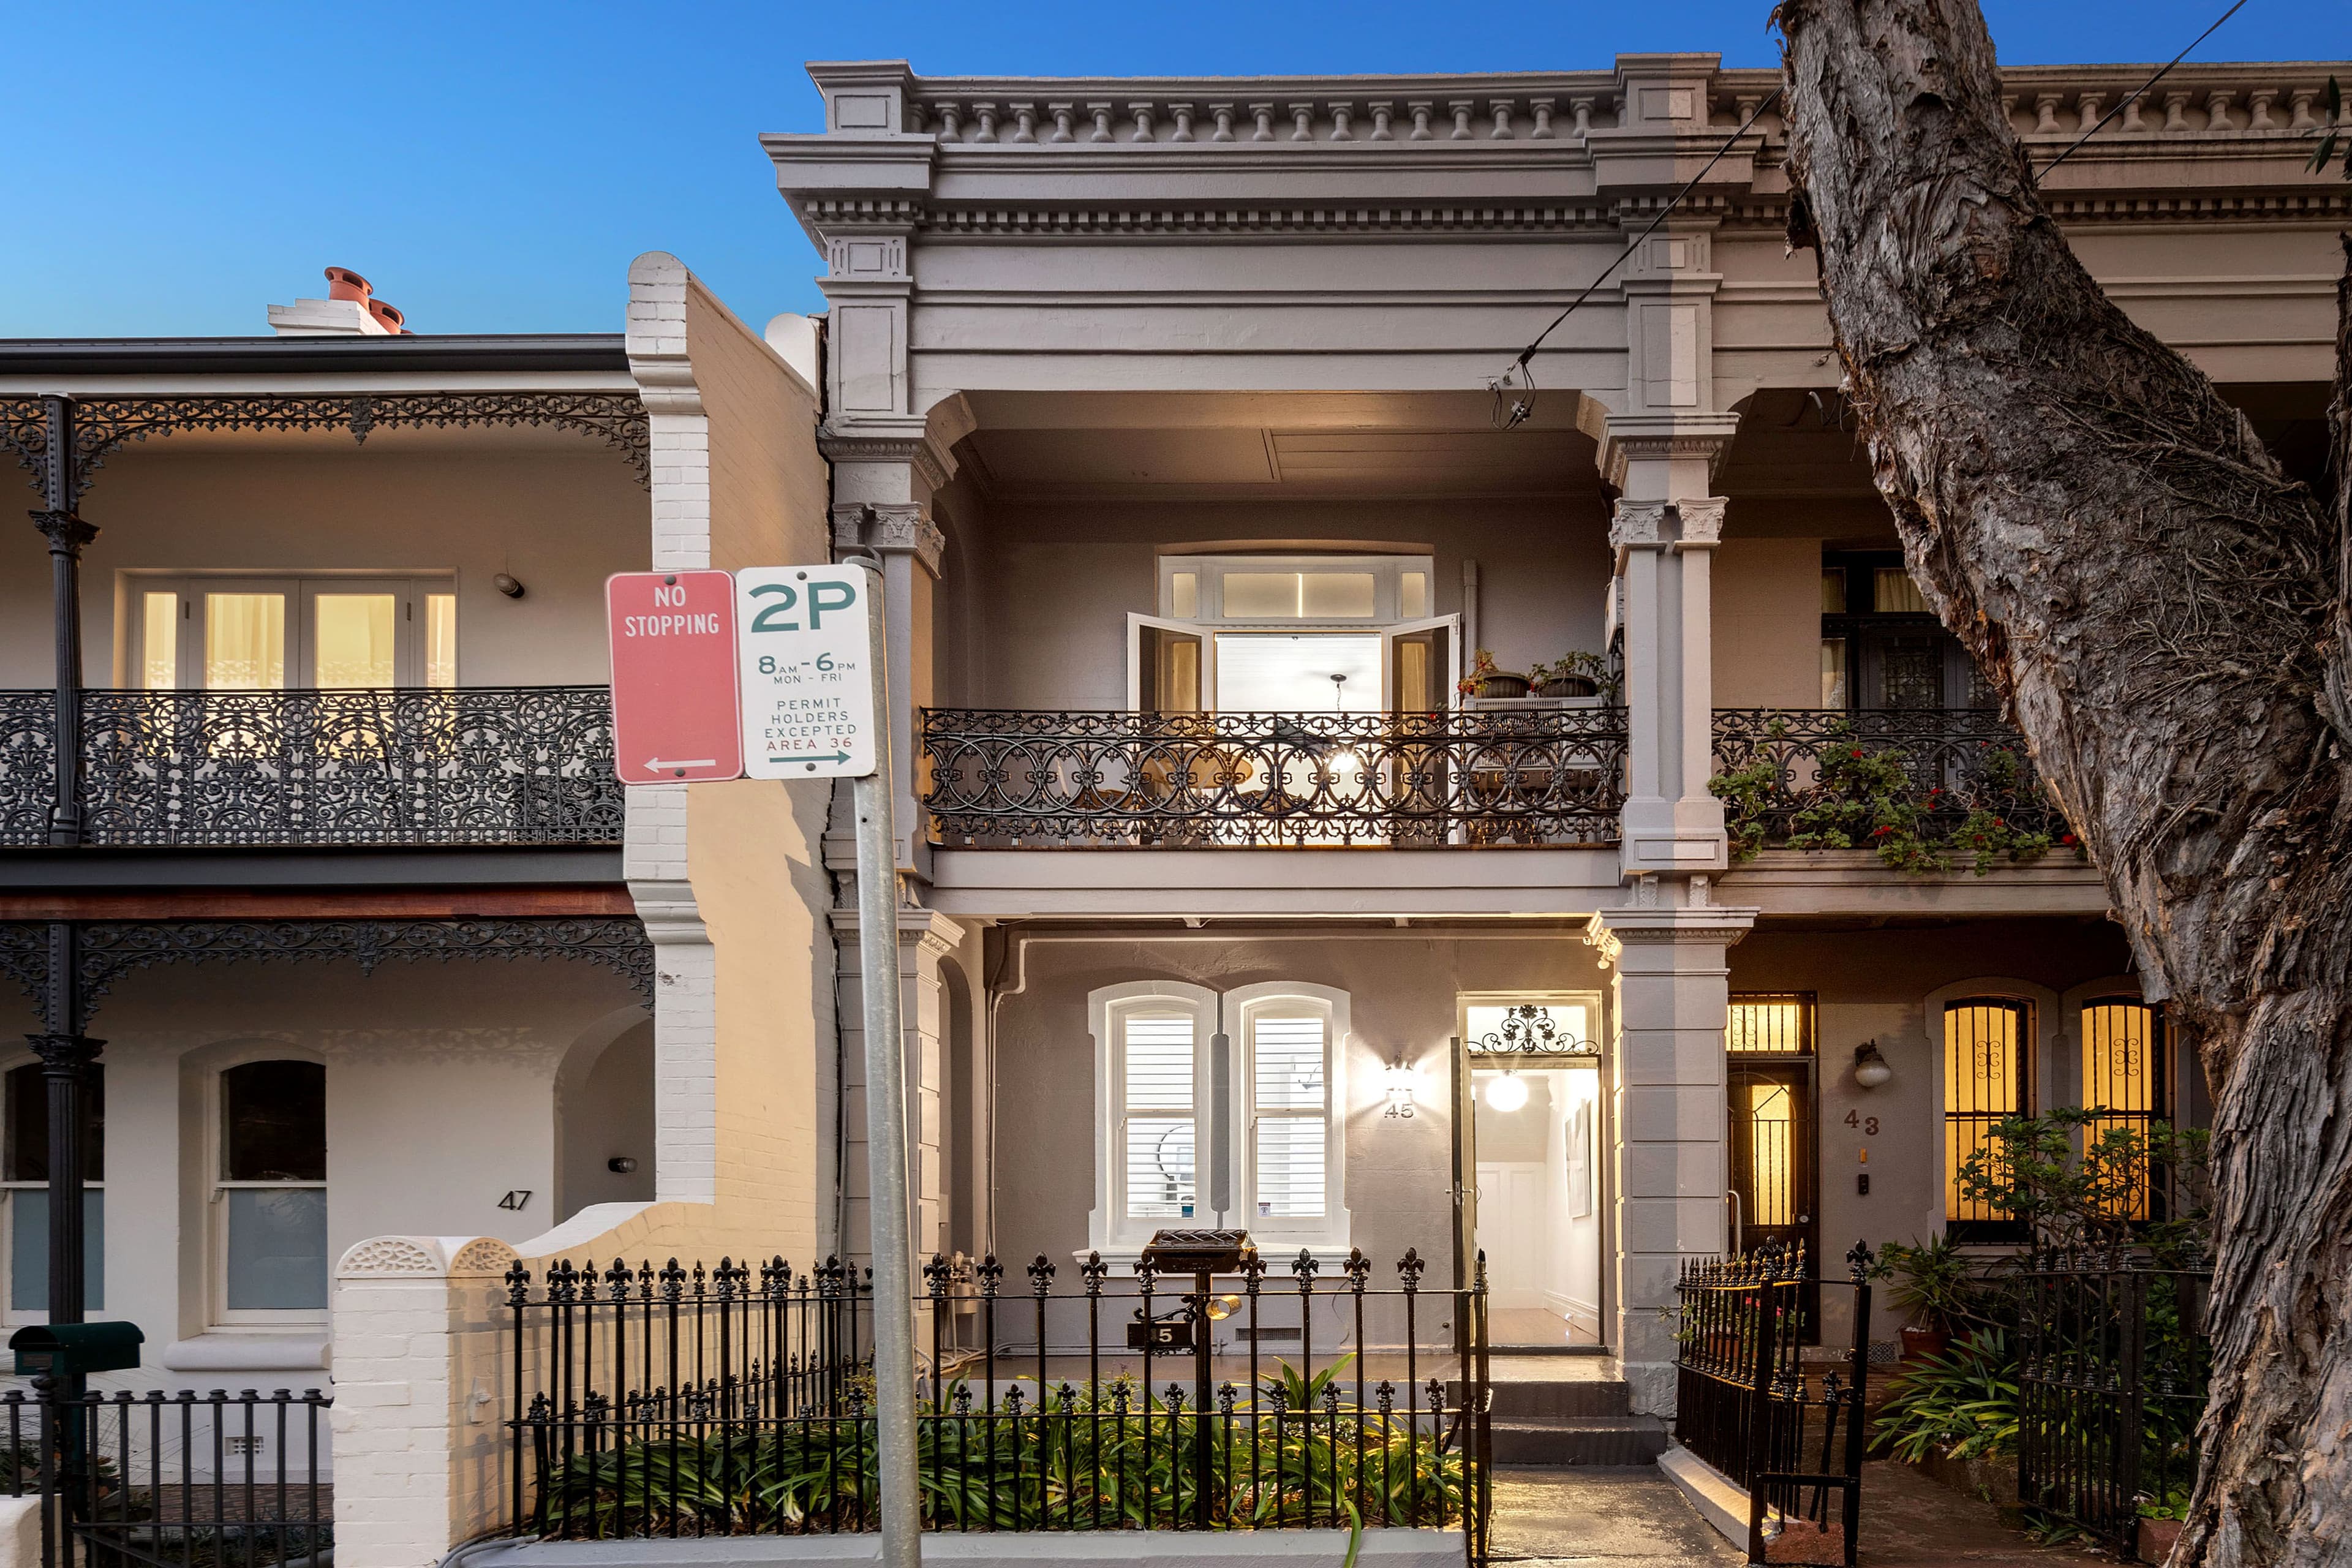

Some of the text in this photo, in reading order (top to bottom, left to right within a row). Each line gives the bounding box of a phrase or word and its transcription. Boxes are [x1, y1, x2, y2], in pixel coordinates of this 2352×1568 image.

[655, 586, 685, 607] NO
[748, 581, 856, 633] 2P
[625, 613, 719, 637] STOPPING
[774, 675, 801, 685] MON
[821, 673, 842, 682] FRI
[777, 698, 841, 711] PERMIT
[771, 710, 848, 725] HOLDERS
[764, 724, 856, 739] EXCEPTED
[766, 737, 852, 752] AREA 36
[1384, 1103, 1414, 1118] 45
[1844, 1109, 1879, 1136] 43
[497, 1190, 532, 1210] 47
